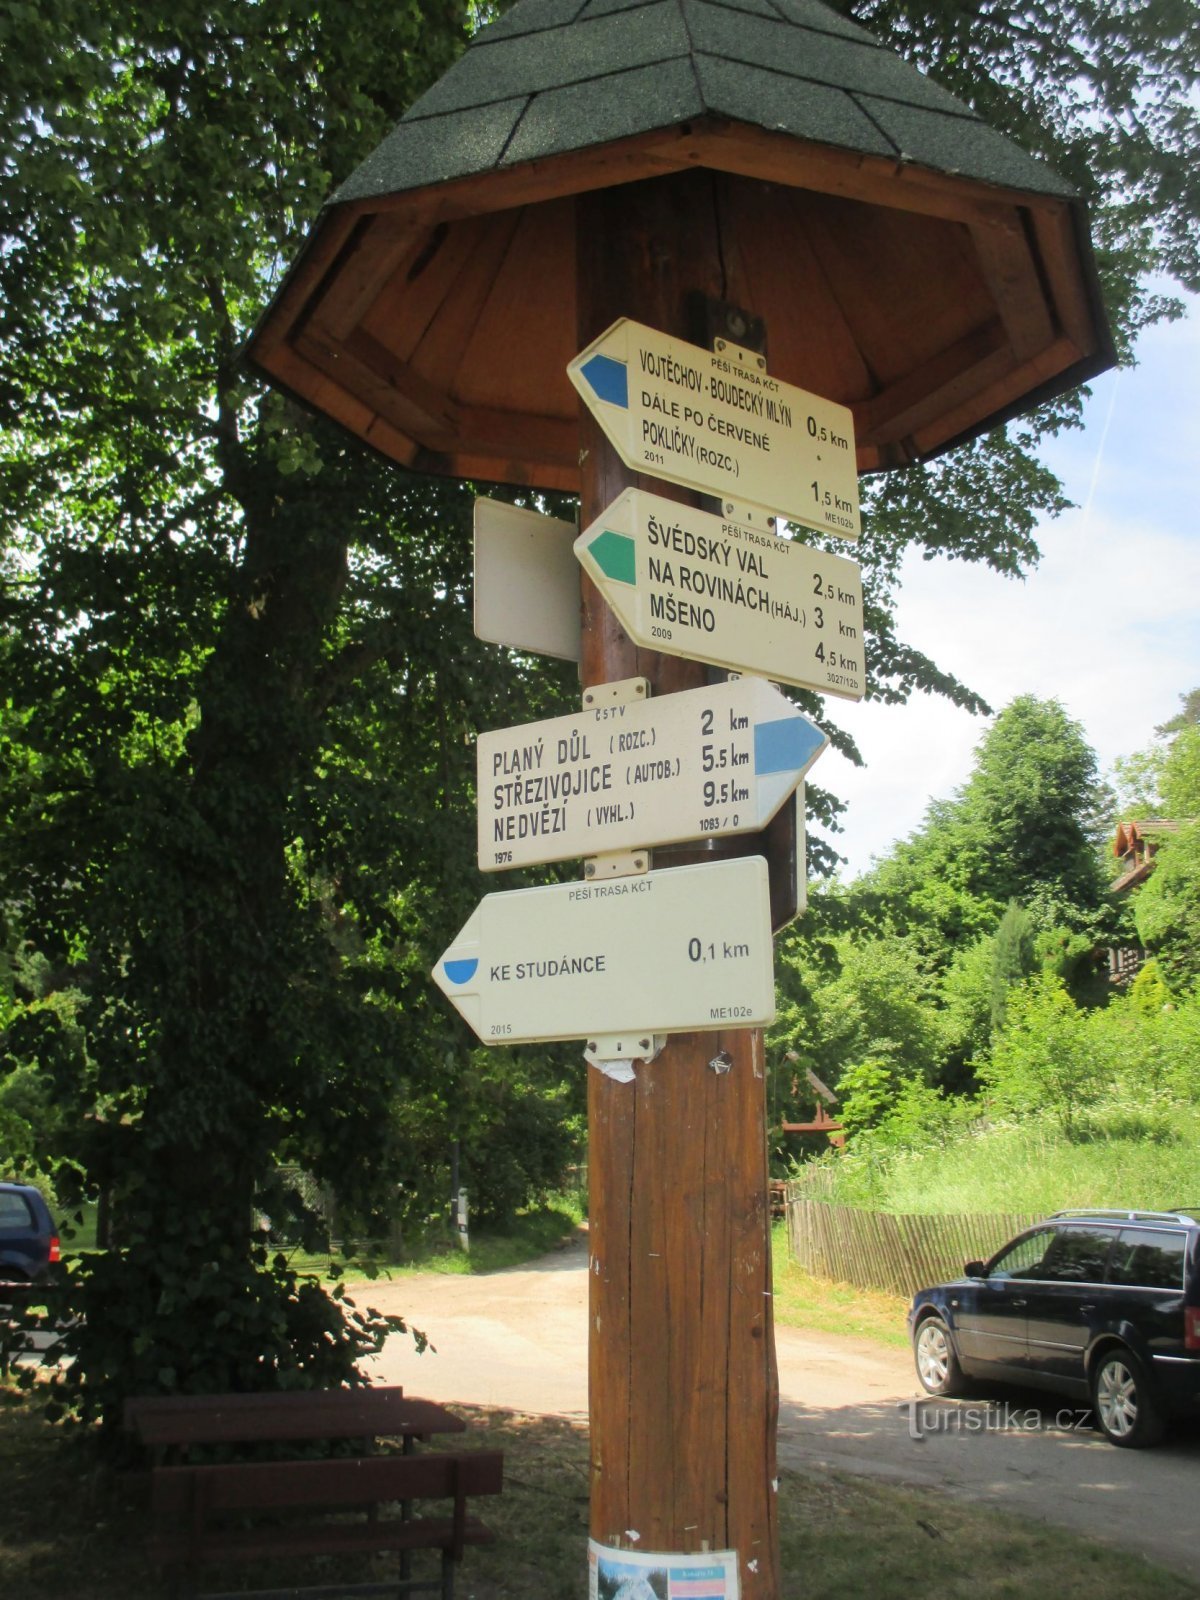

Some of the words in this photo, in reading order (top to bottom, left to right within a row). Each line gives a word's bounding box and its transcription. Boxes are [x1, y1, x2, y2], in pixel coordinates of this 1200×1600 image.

[711, 357, 731, 373] PĚŠÍ
[733, 366, 762, 385] TRASA
[762, 374, 780, 393] KČT
[639, 349, 702, 393] VOJTĚCHOV
[710, 377, 763, 417] BOUDECKÝ
[767, 399, 792, 428] MLÝN
[641, 390, 680, 419] DÁLE
[684, 409, 704, 427] PO
[707, 412, 770, 452] ČERVENÉ
[831, 430, 848, 450] km
[644, 450, 664, 465] 2011
[834, 495, 853, 513] km
[825, 512, 854, 529] ME102b
[648, 516, 731, 566] ŠVÉDSKÝ
[736, 548, 768, 579] VAL
[722, 524, 741, 539] PĚŠÍ
[744, 532, 772, 548] TRASA
[772, 538, 790, 554] KČT
[649, 557, 675, 587] NA
[838, 587, 856, 606] km
[650, 592, 716, 632] MŠENO
[814, 606, 824, 629] 3
[839, 620, 856, 638] km
[652, 626, 672, 640] 2009
[840, 654, 858, 672] km
[827, 672, 858, 688] 3027/12b
[493, 738, 543, 776] PLANÝ
[558, 729, 591, 764] DŮL
[700, 709, 714, 735] 2
[730, 708, 749, 731] km
[494, 764, 612, 810] STŘEZIVOJICE
[731, 744, 749, 766] km
[494, 799, 567, 842] NEDVĚZÍ
[731, 779, 749, 801] km
[699, 818, 720, 831] 1083
[494, 852, 513, 864] 1976
[568, 889, 592, 901] PĚŠÍ
[595, 885, 629, 898] TRASA
[631, 880, 652, 895] KČT
[489, 965, 511, 981] KE
[516, 955, 606, 980] STUDÁNCE
[723, 942, 750, 958] km
[710, 1007, 753, 1019] ME102e
[491, 1024, 512, 1035] 2015
